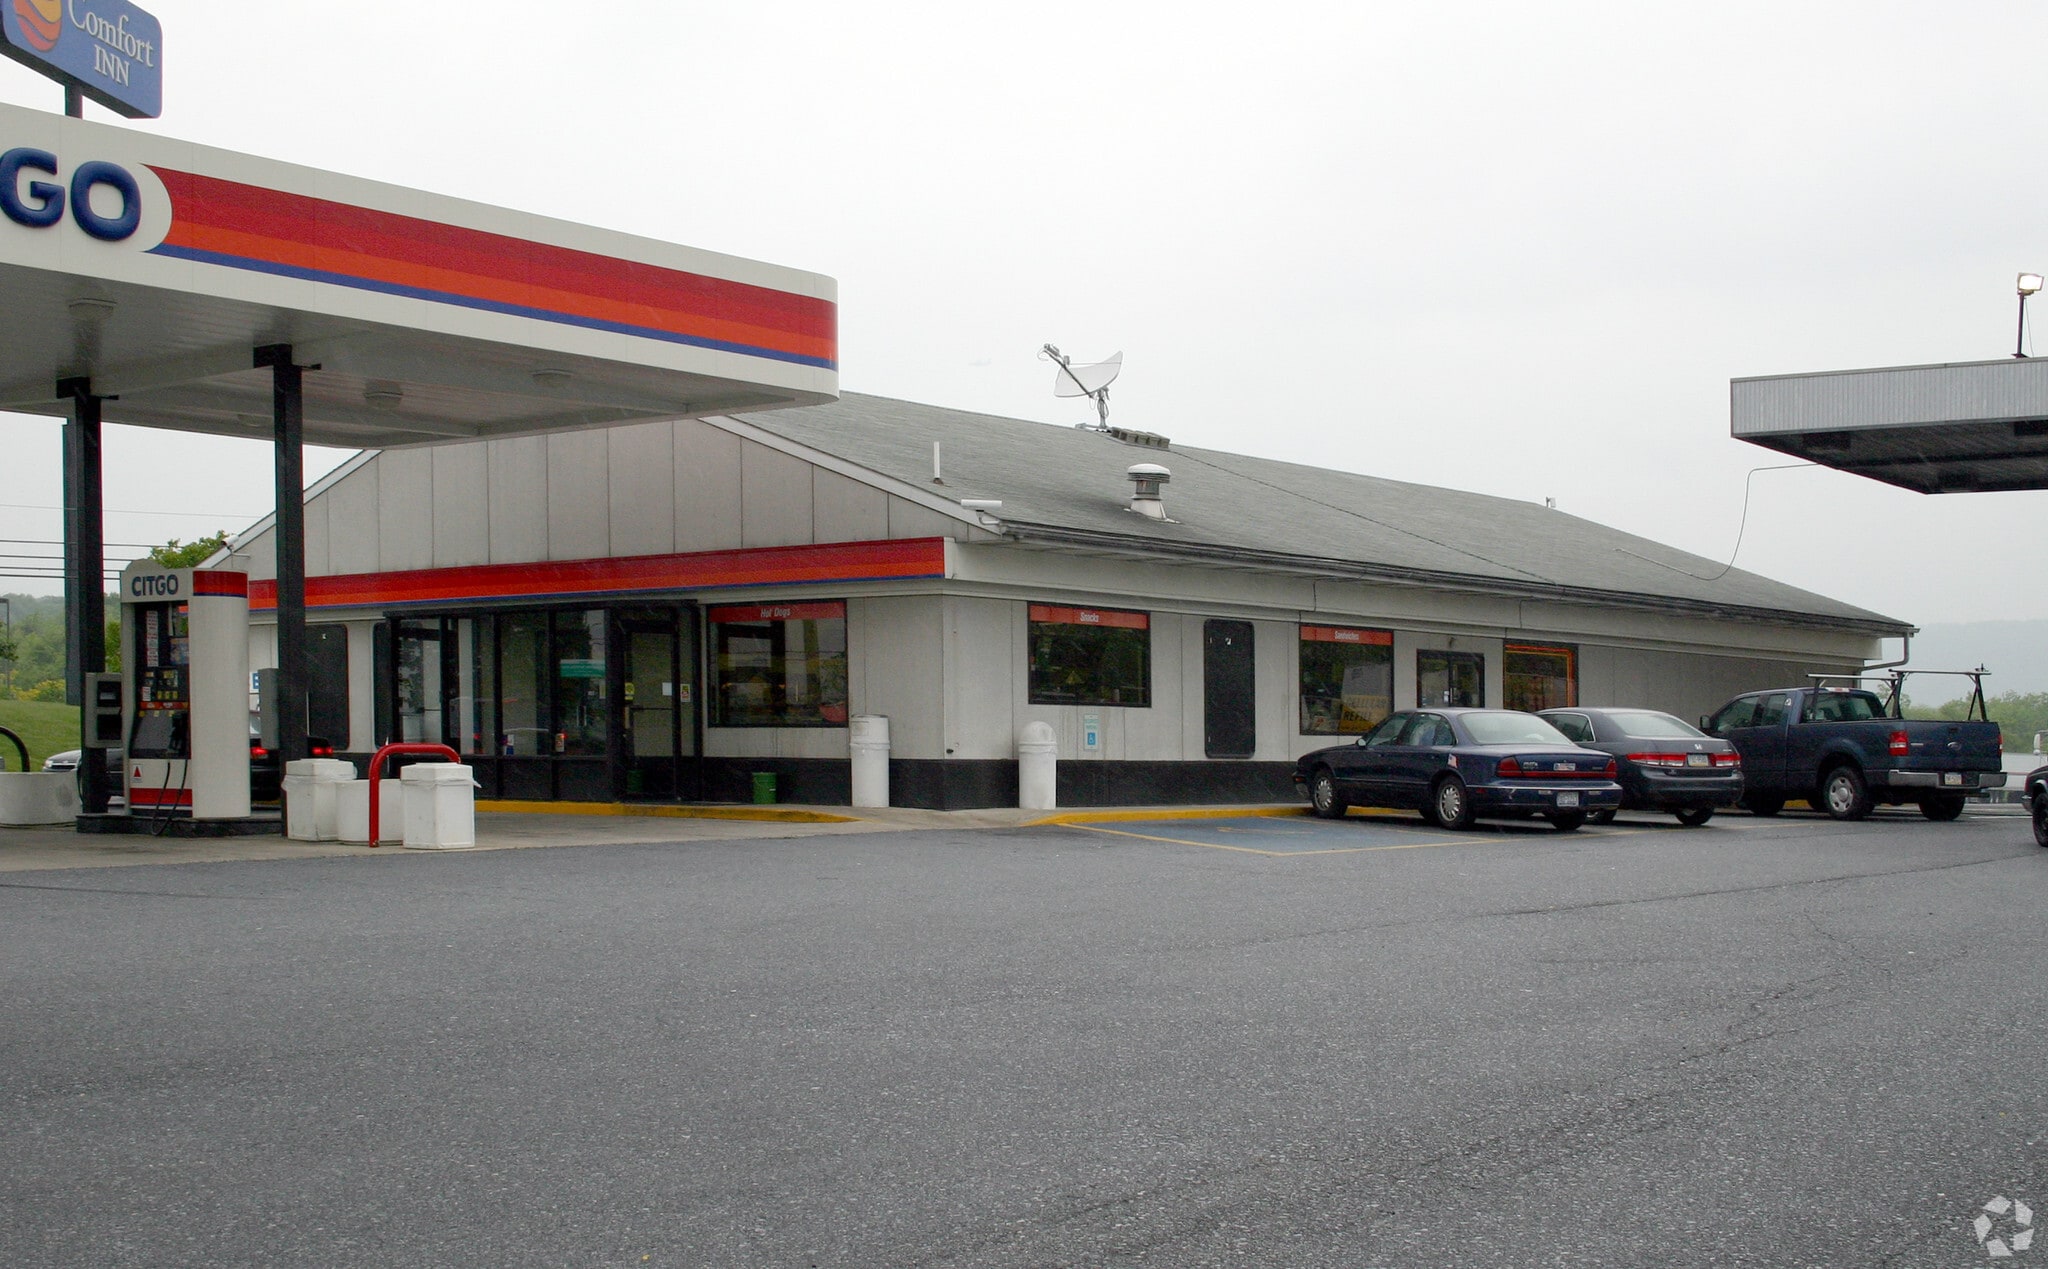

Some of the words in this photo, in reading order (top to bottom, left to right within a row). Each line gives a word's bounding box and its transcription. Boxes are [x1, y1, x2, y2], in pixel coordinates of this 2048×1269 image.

[67, 0, 154, 68] Comfort
[94, 44, 130, 87] INN
[0, 147, 142, 242] GO
[131, 574, 179, 597] CITGO
[761, 608, 772, 618] Hot
[774, 607, 790, 618] Dogs
[1080, 612, 1099, 622] Snacks
